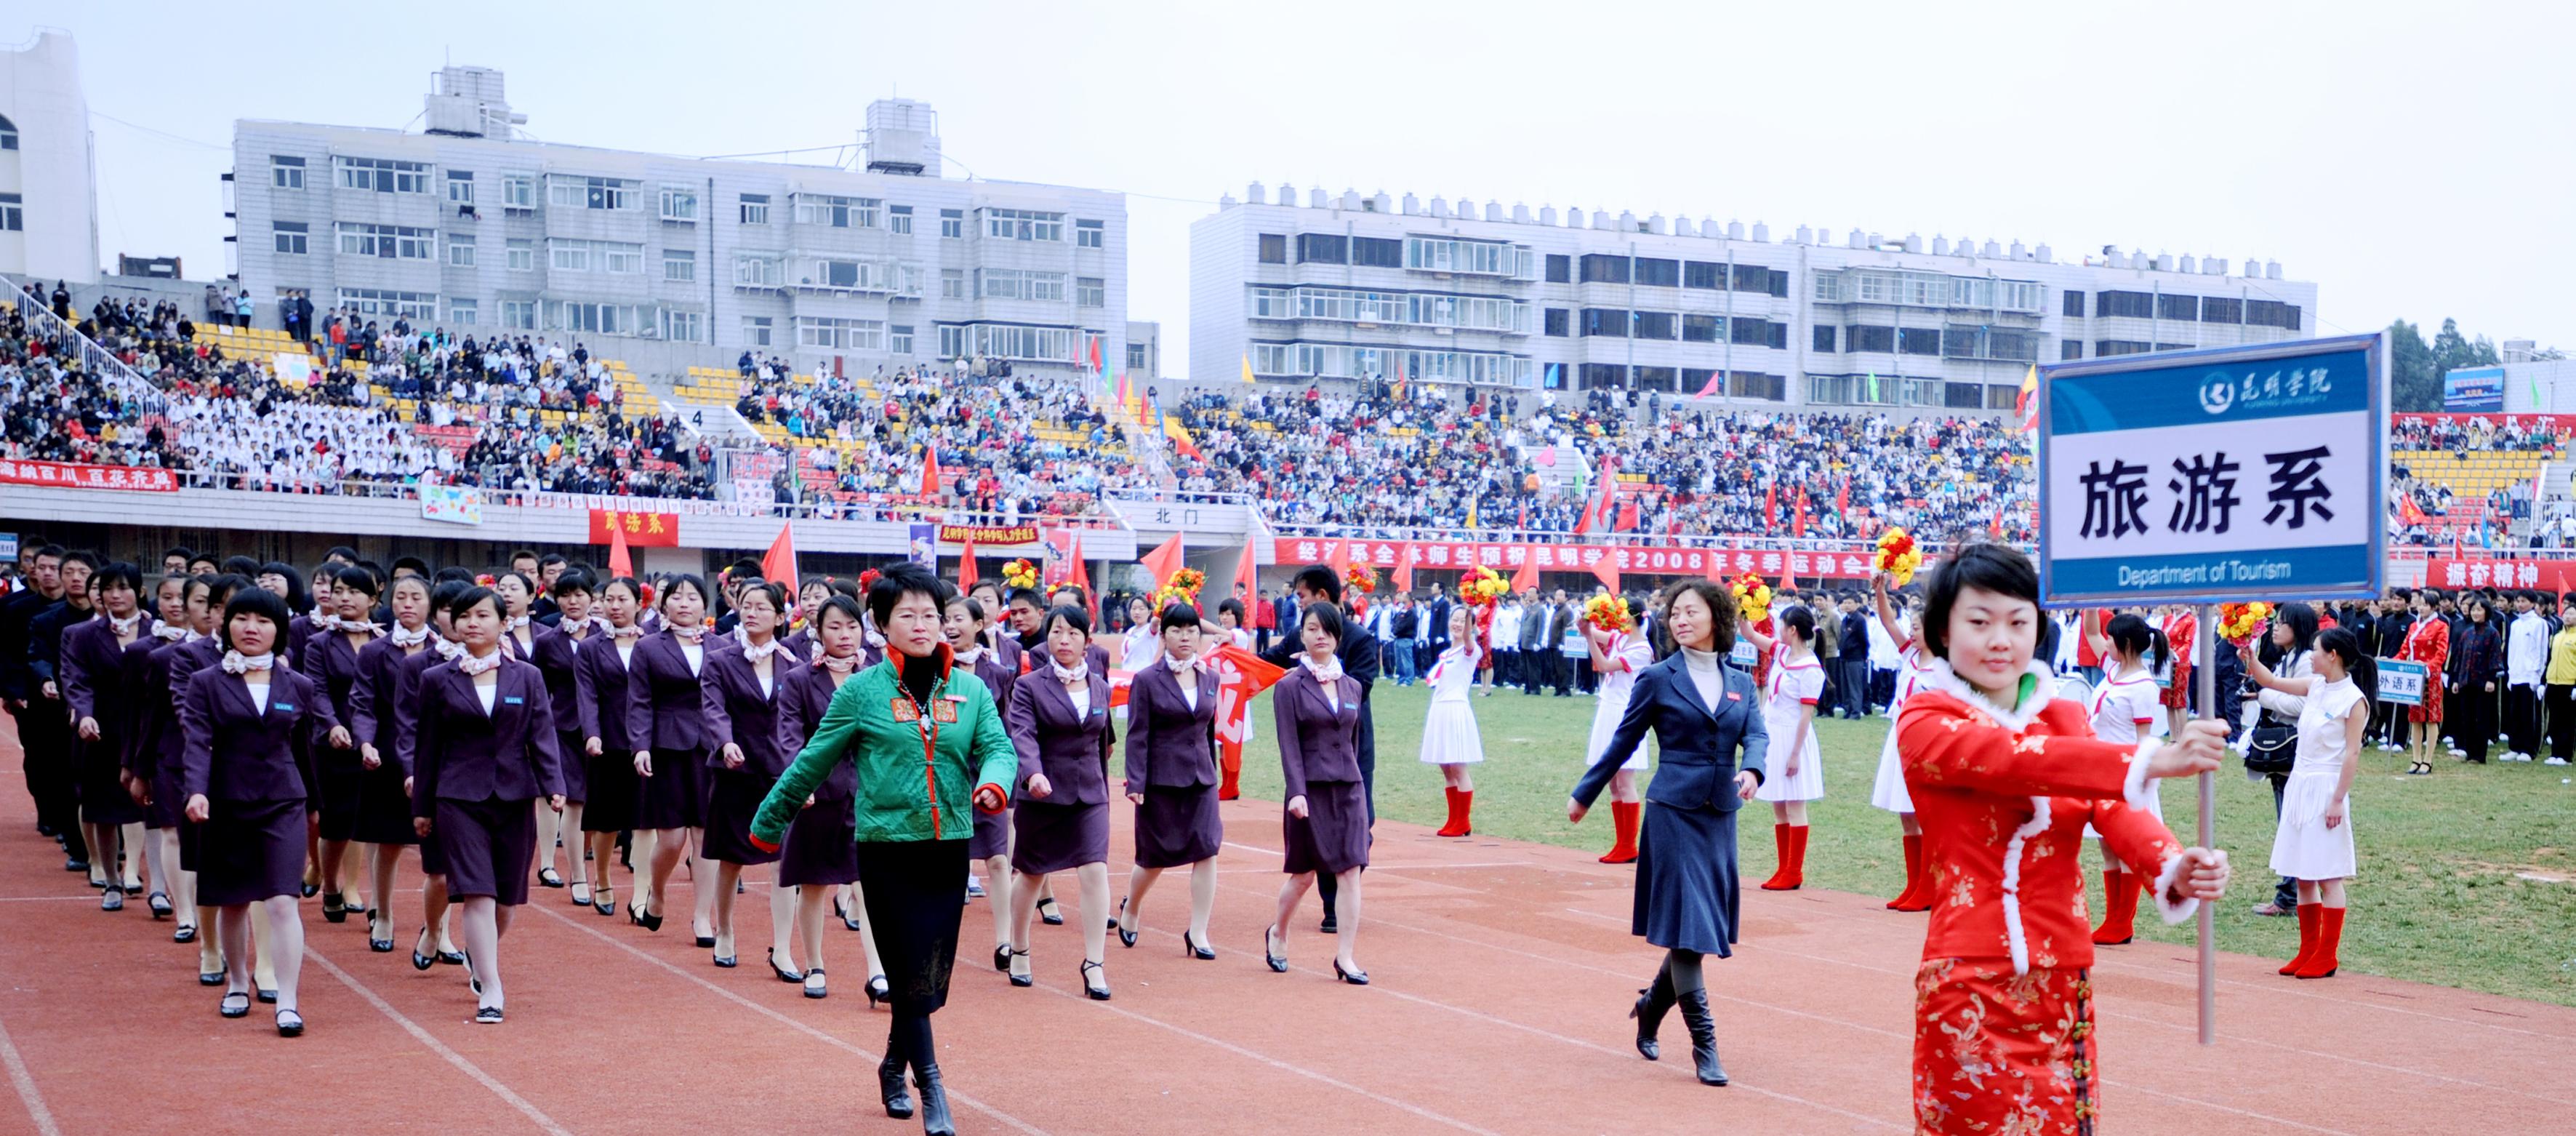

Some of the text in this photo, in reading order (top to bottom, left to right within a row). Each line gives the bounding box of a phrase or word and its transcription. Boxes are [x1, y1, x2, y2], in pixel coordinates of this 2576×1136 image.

[2240, 367, 2332, 401] 昆明学院
[692, 410, 703, 427] 4
[2079, 445, 2333, 540] 旅游系
[1156, 507, 1198, 524] 北门
[2118, 559, 2291, 590] Department of Tourism
[2446, 561, 2539, 588] 振奋精神
[2378, 675, 2417, 692] 外语系
